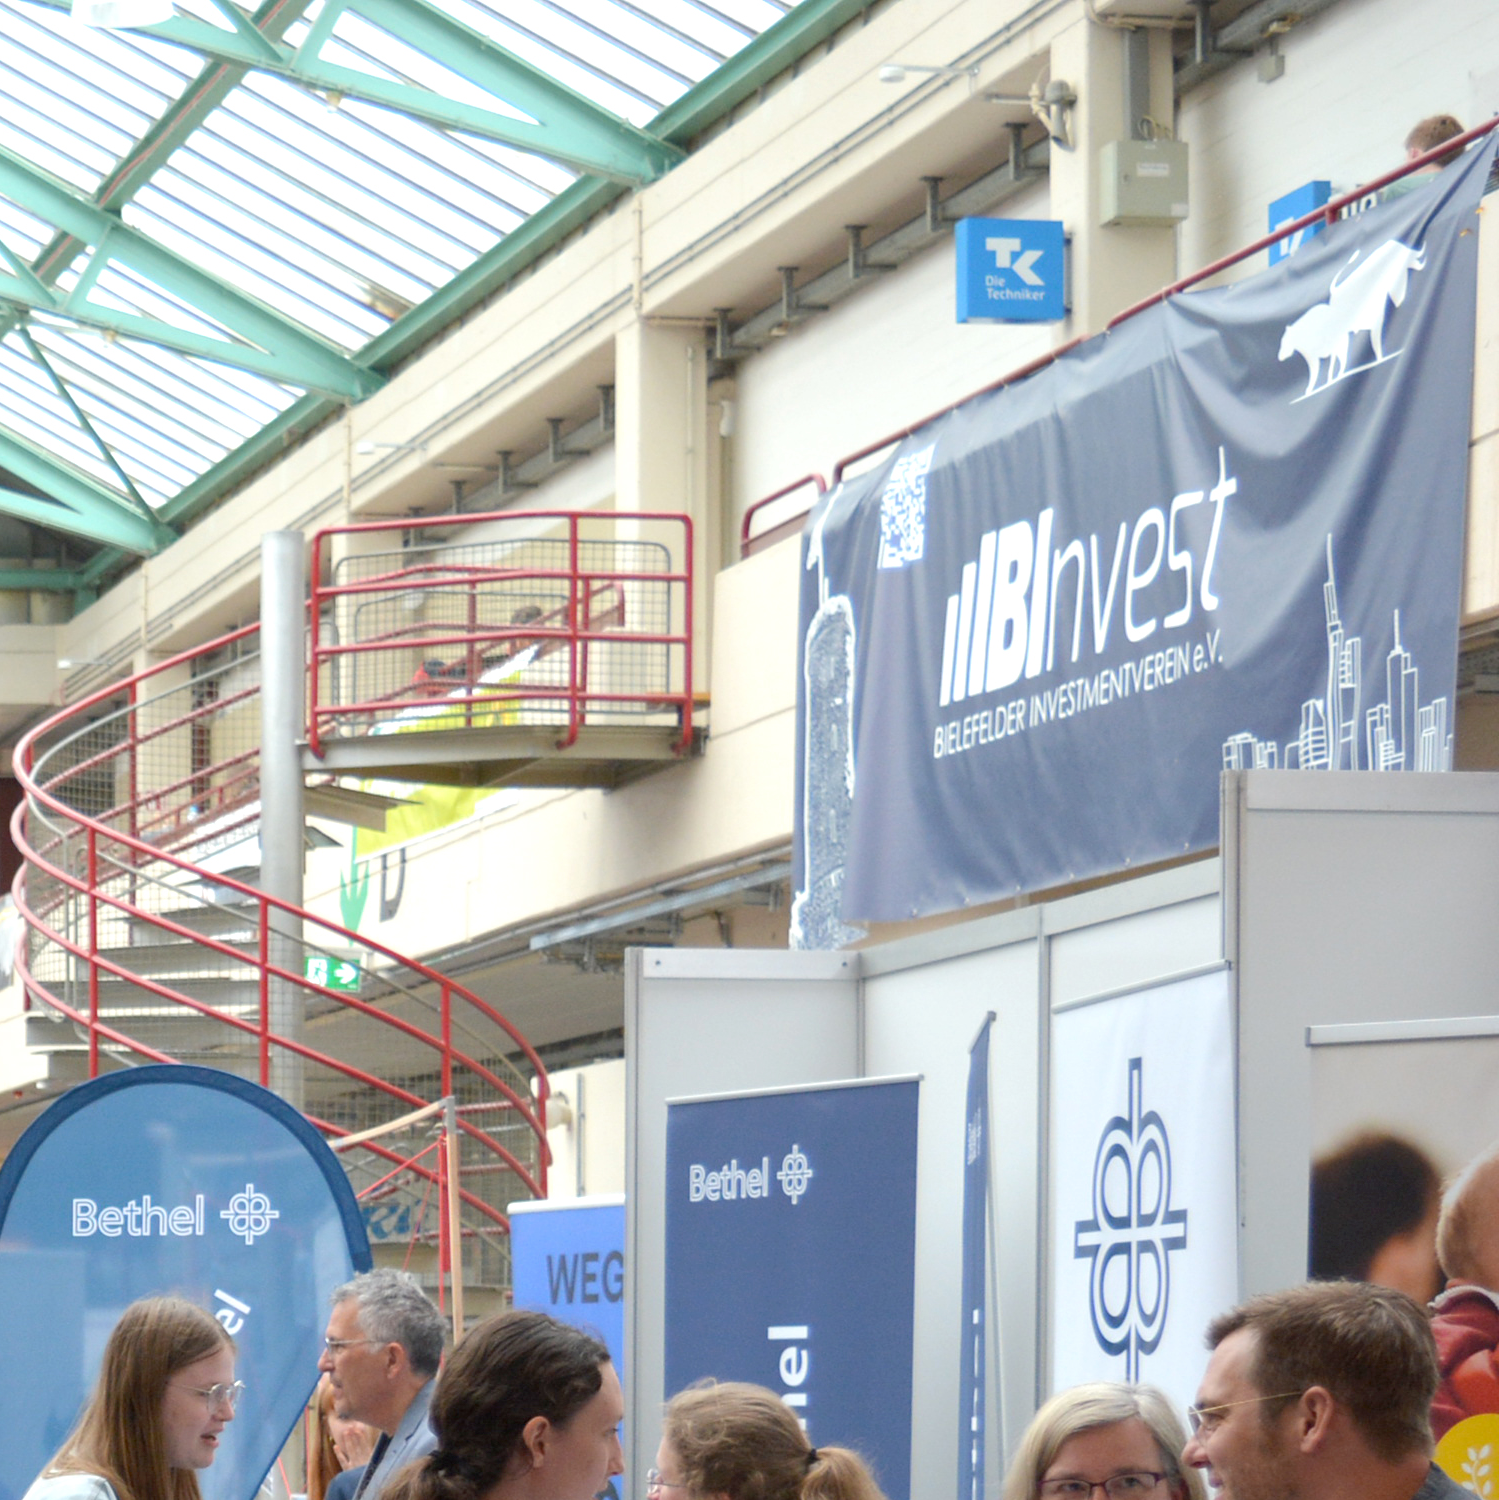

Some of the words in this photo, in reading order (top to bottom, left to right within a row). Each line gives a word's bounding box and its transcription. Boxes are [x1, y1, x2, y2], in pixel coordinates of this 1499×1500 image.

[985, 237, 1045, 286] TK
[985, 275, 1006, 288] Die
[986, 287, 1046, 301] Techniker
[933, 698, 1026, 760] BIELEFELDER
[1029, 641, 1191, 729] INVESTMENTVEREIN
[1193, 628, 1224, 673] e.V.
[689, 1156, 770, 1203] Bethel
[72, 1194, 205, 1237] Bethel
